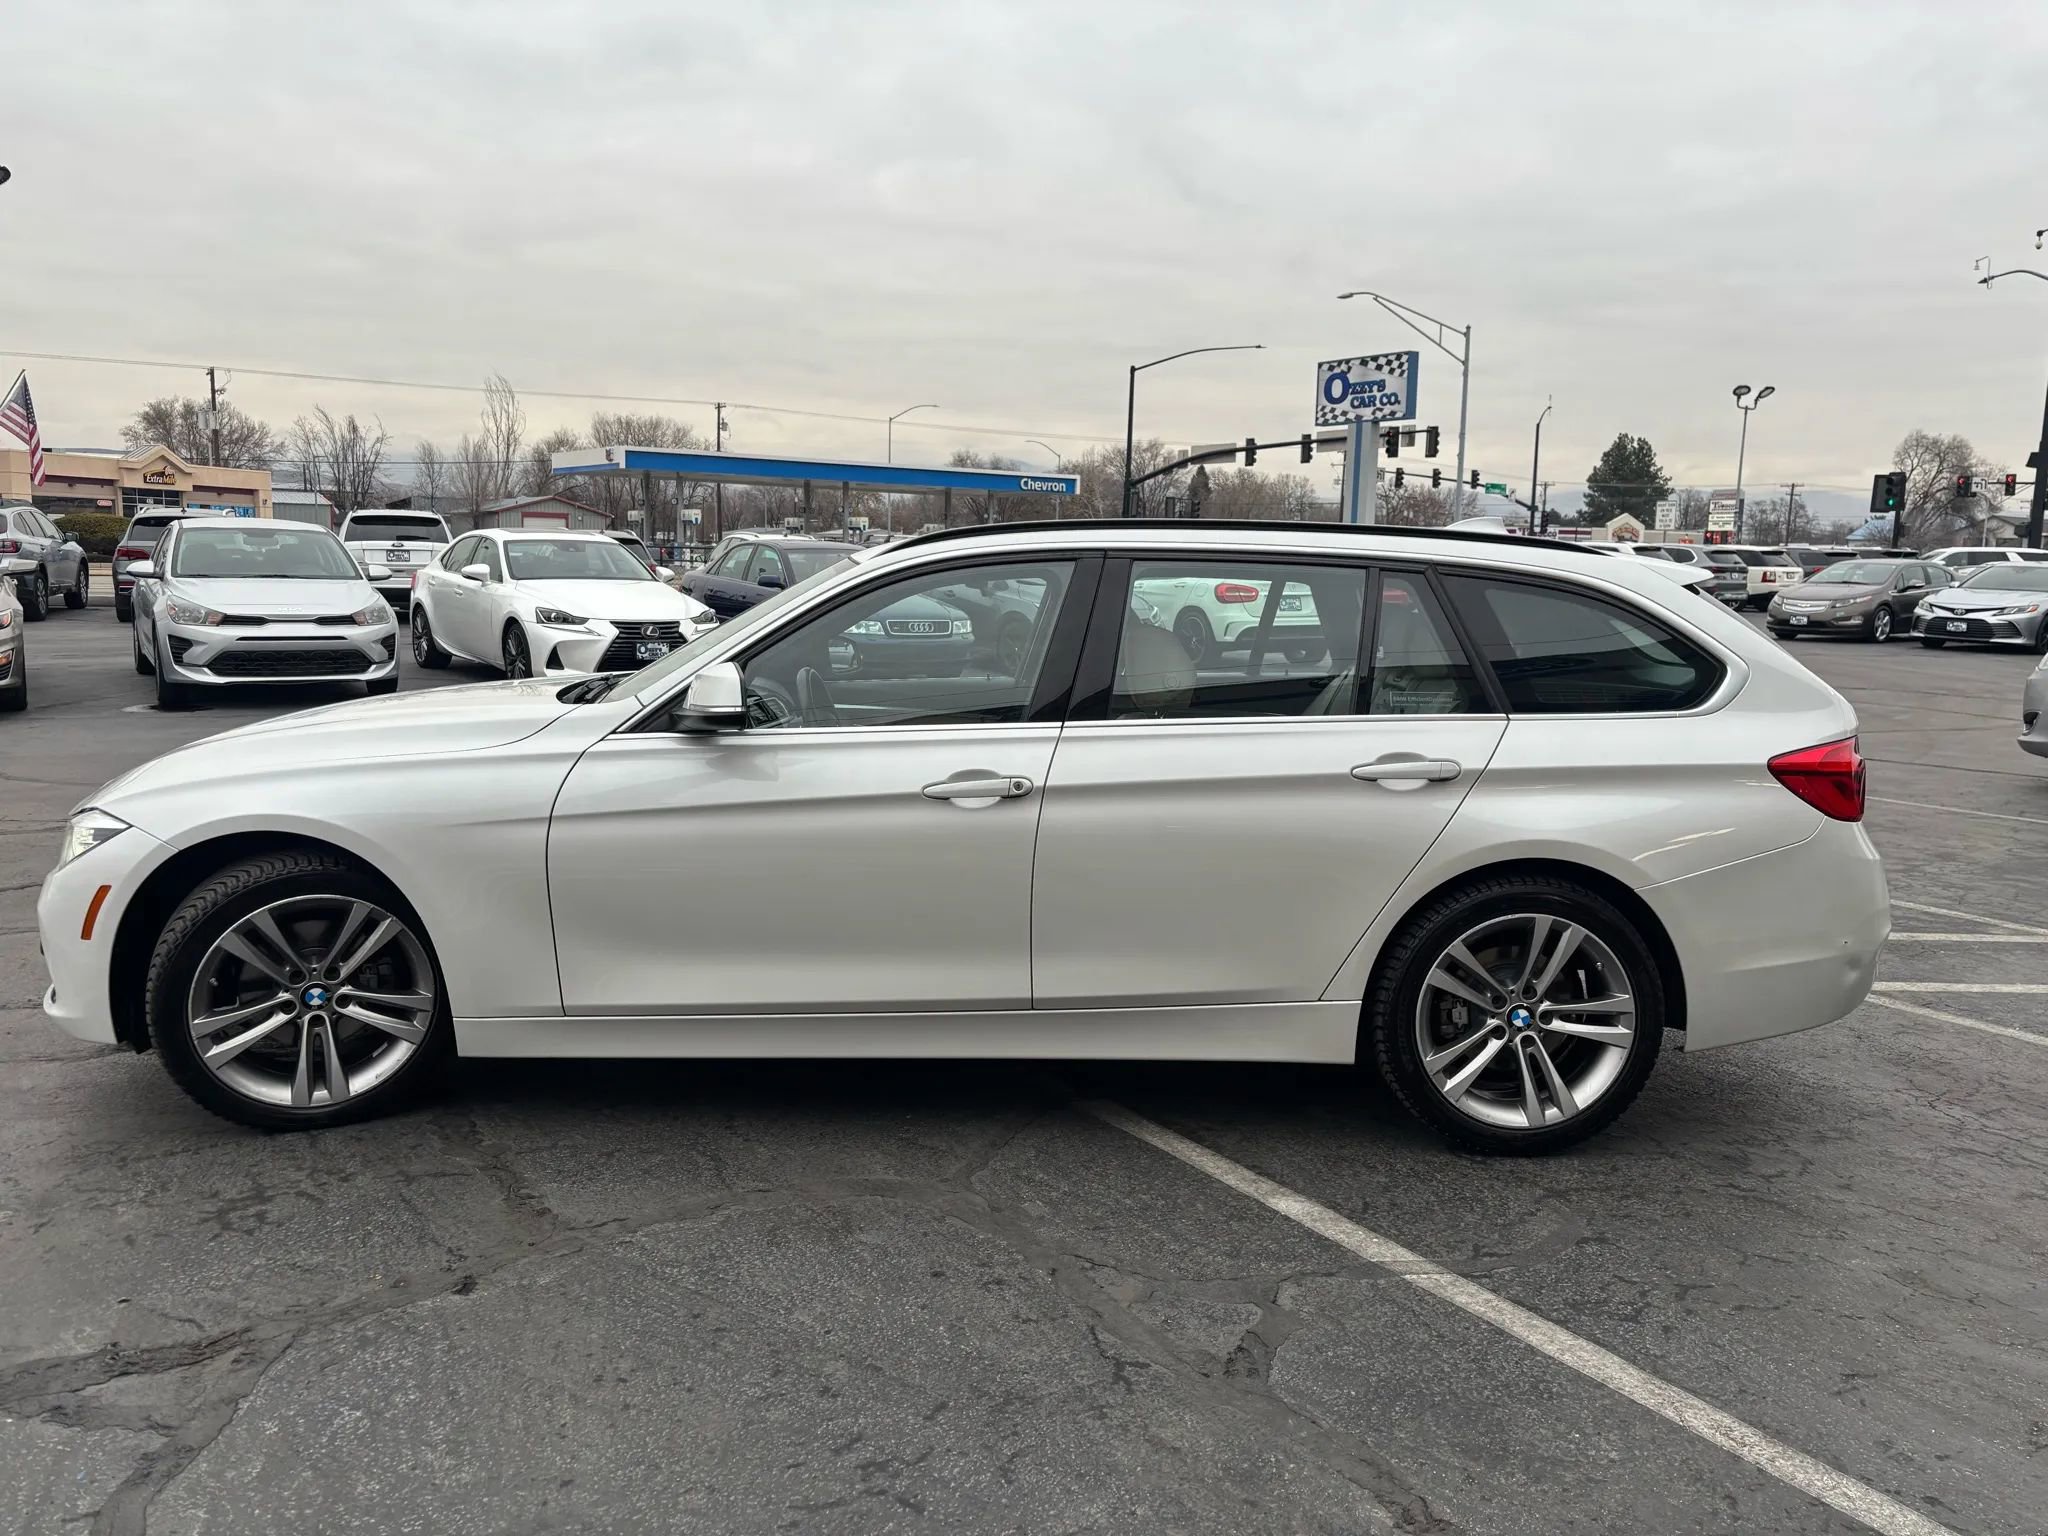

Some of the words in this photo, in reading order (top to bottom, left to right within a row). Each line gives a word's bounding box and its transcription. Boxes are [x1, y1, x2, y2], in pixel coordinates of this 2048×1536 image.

[1323, 371, 1387, 405] OZZY'S
[1350, 396, 1377, 409] CAR
[1379, 392, 1402, 406] CO.
[1020, 478, 1067, 492] Chevron
